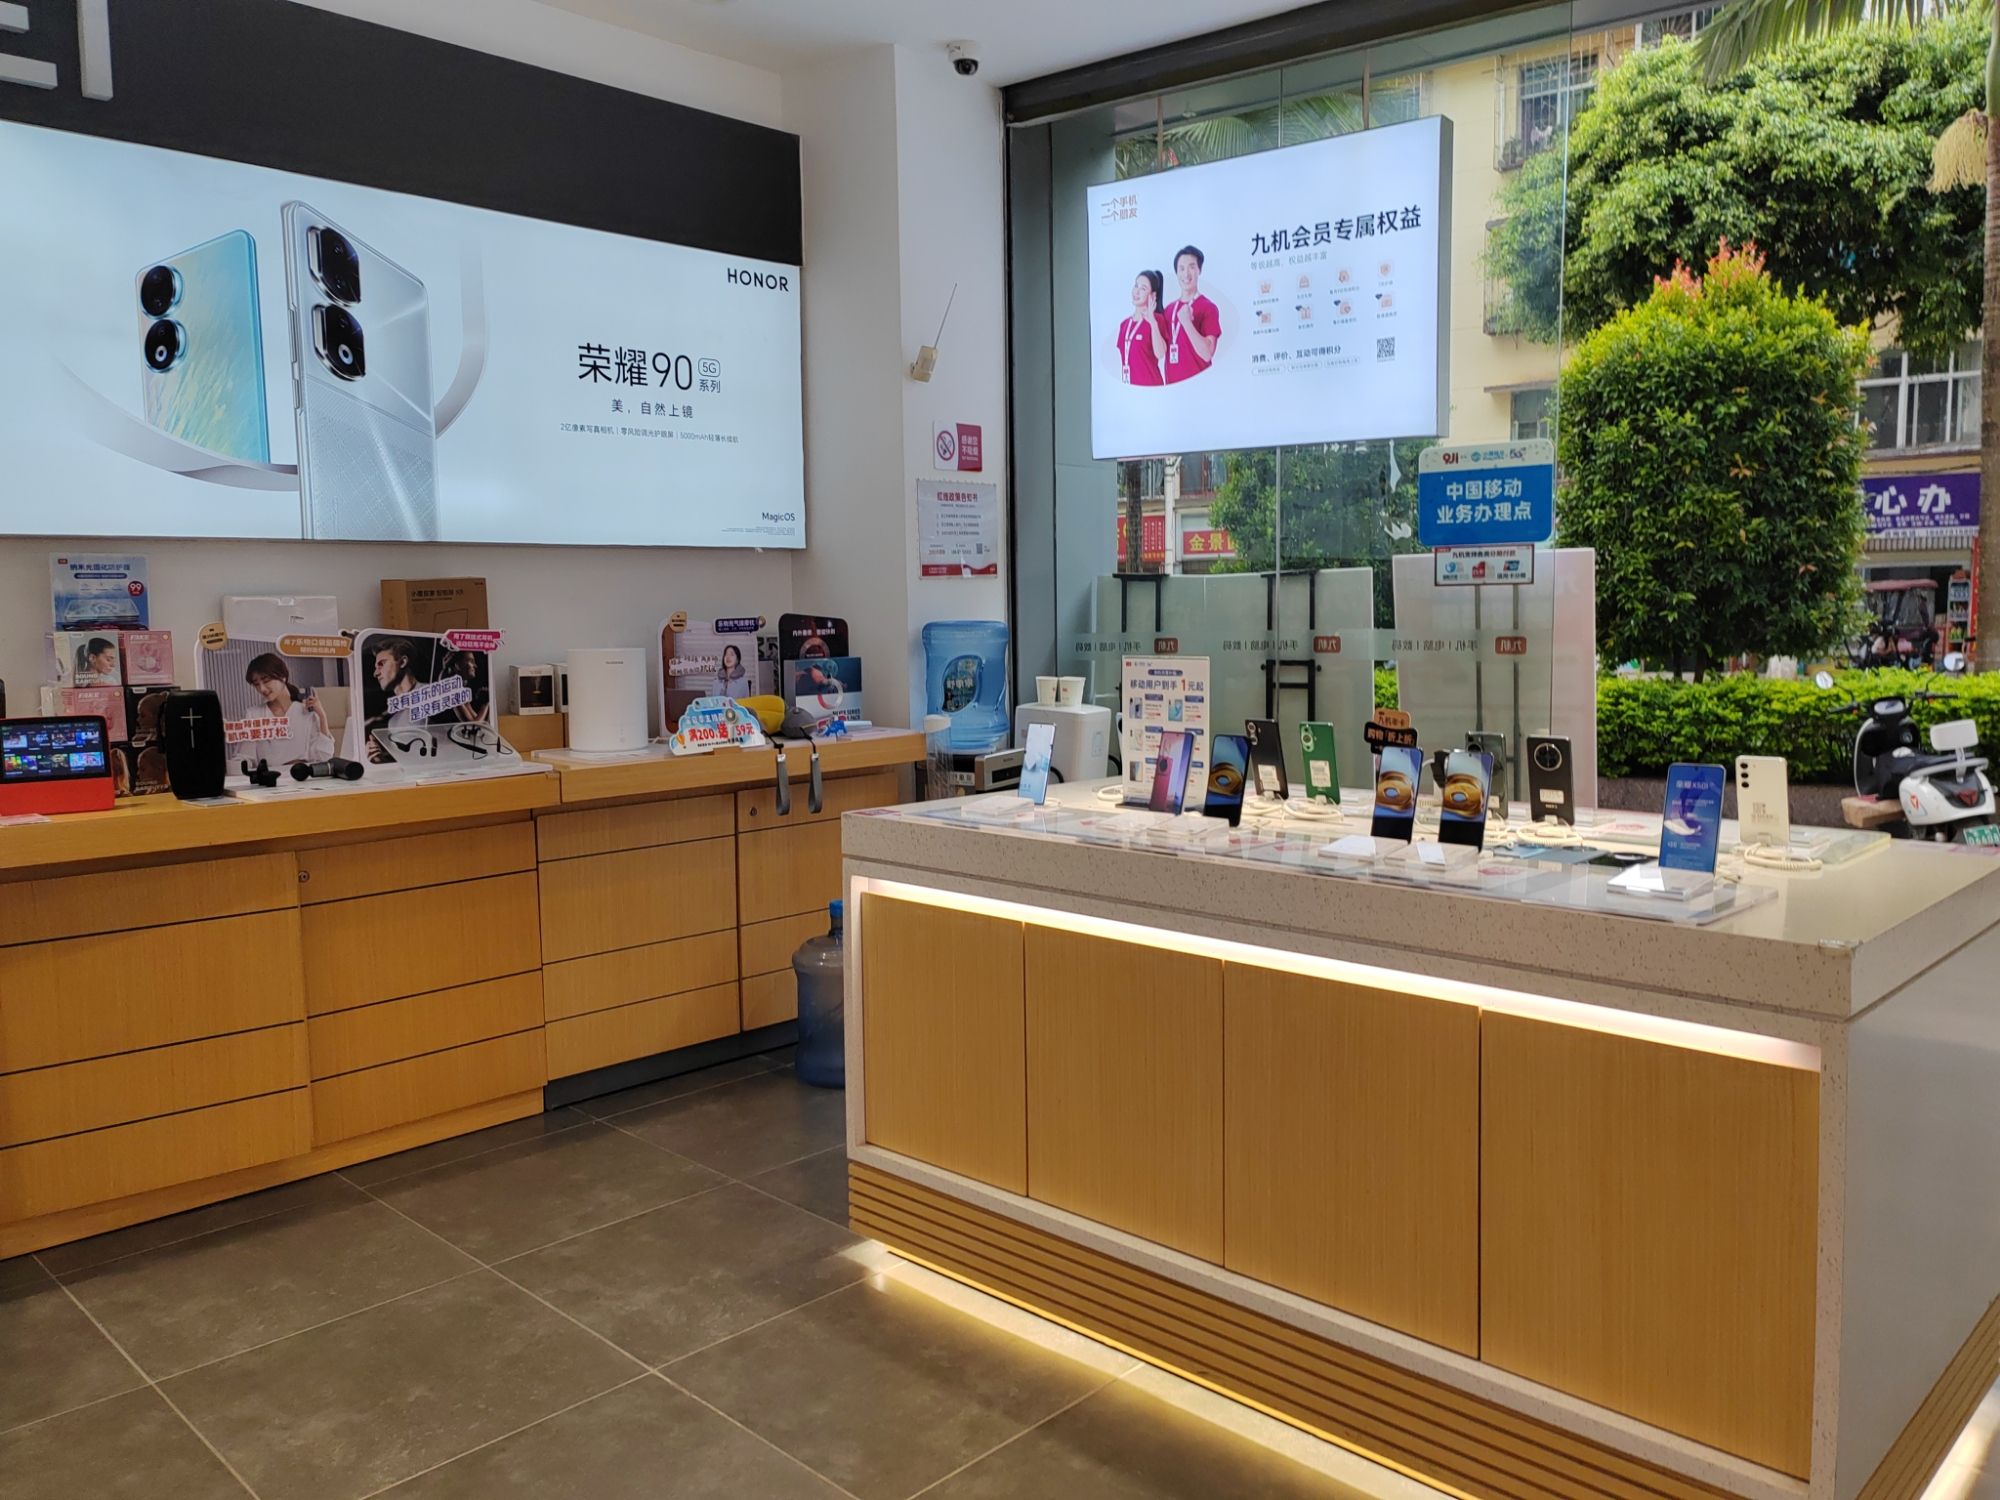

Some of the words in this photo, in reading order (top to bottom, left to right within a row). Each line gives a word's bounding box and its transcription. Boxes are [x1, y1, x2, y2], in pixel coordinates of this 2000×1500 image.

[1251, 204, 1421, 256] 九机会员专属权益
[727, 267, 789, 292] HONOR
[578, 342, 693, 391] 荣耀90
[702, 362, 717, 374] 5G
[699, 379, 721, 393] 系列
[611, 399, 694, 419] 美，自然上镜
[1446, 478, 1522, 501] 中国移动
[761, 512, 795, 523] MagicOS
[1436, 501, 1532, 524] 业务办理点
[130, 583, 142, 592] 99
[389, 678, 462, 712] 没有音乐的运动
[411, 689, 471, 720] 是没有灵魂的
